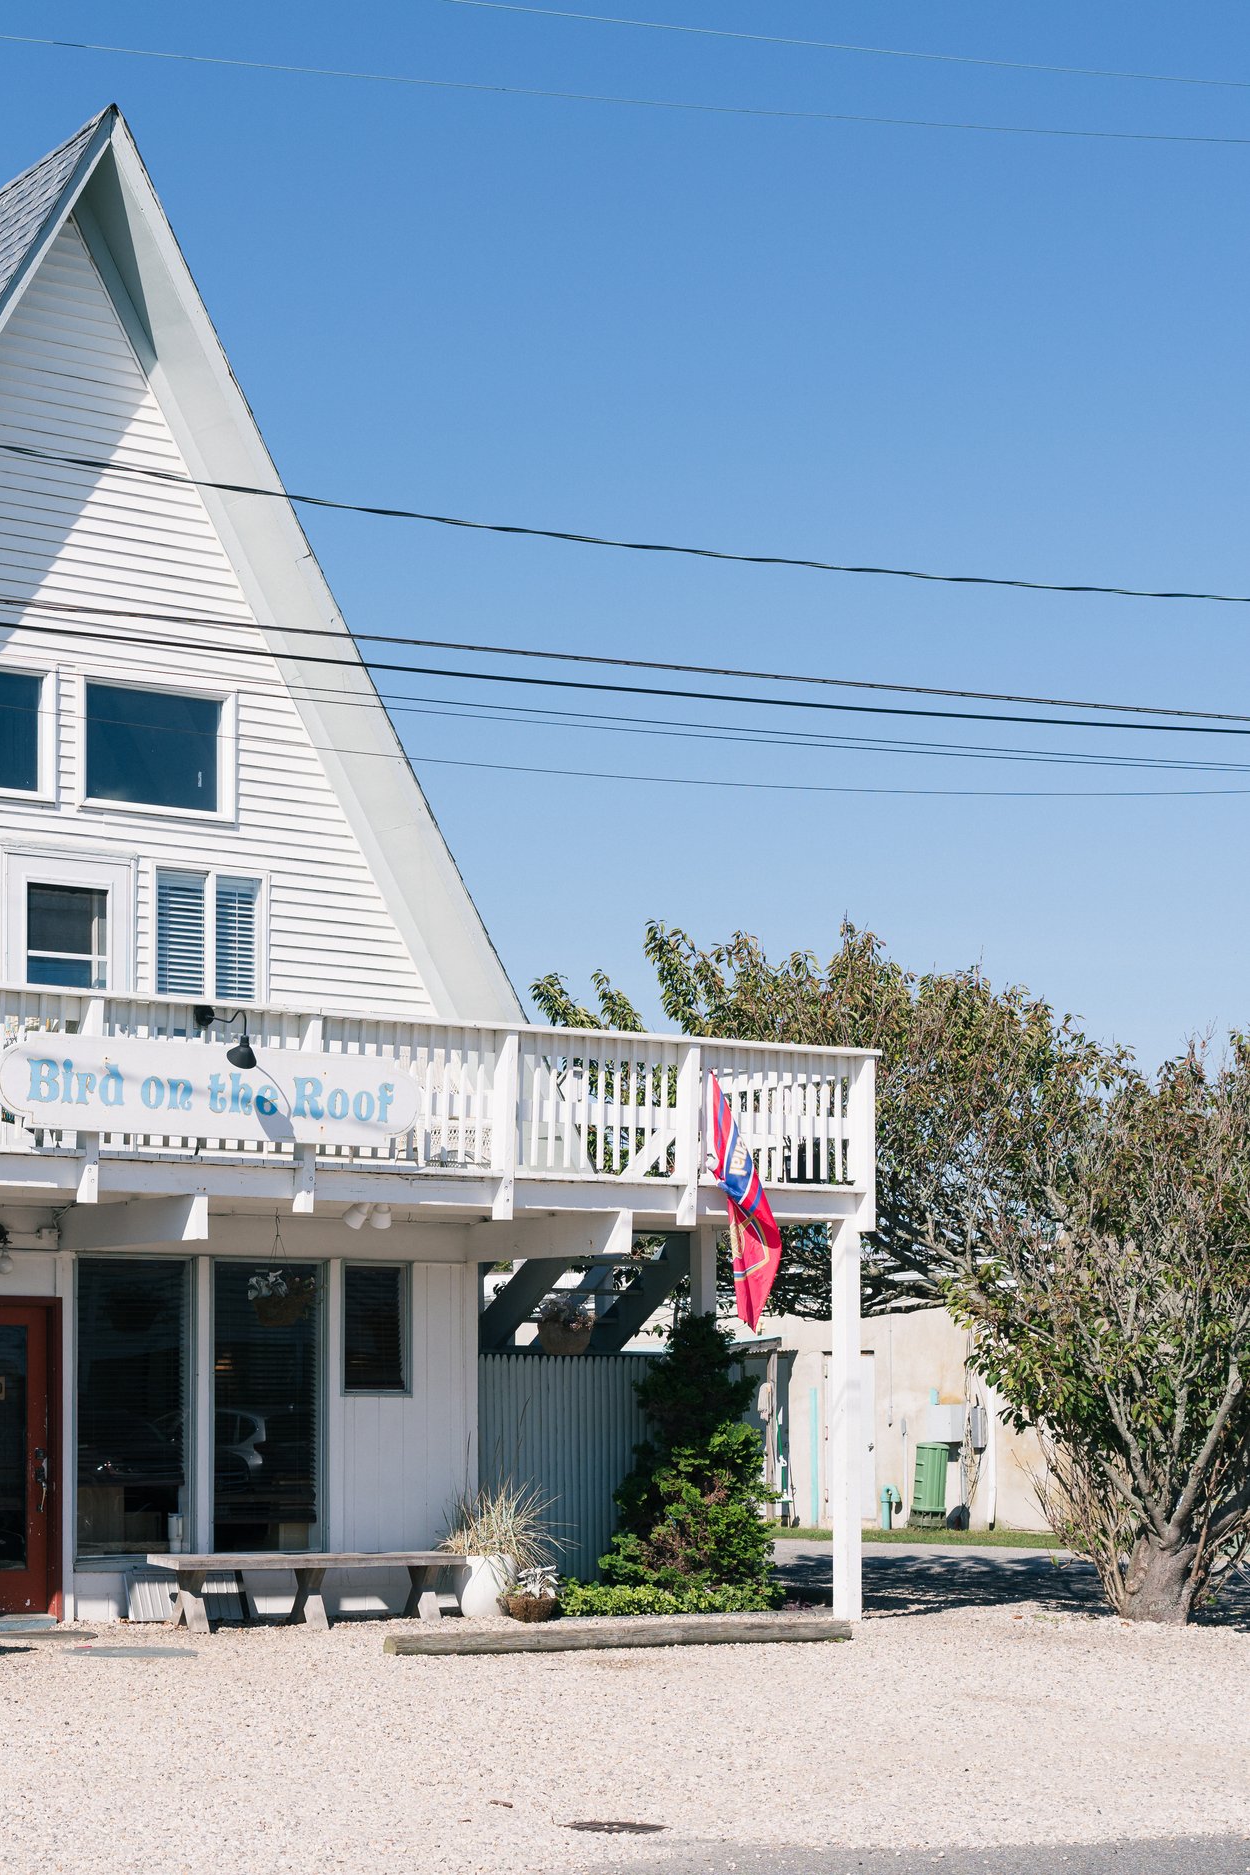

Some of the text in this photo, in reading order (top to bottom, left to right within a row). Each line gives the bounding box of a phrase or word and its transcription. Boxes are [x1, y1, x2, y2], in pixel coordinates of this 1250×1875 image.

[27, 1058, 395, 1123] Bird on the Roof
